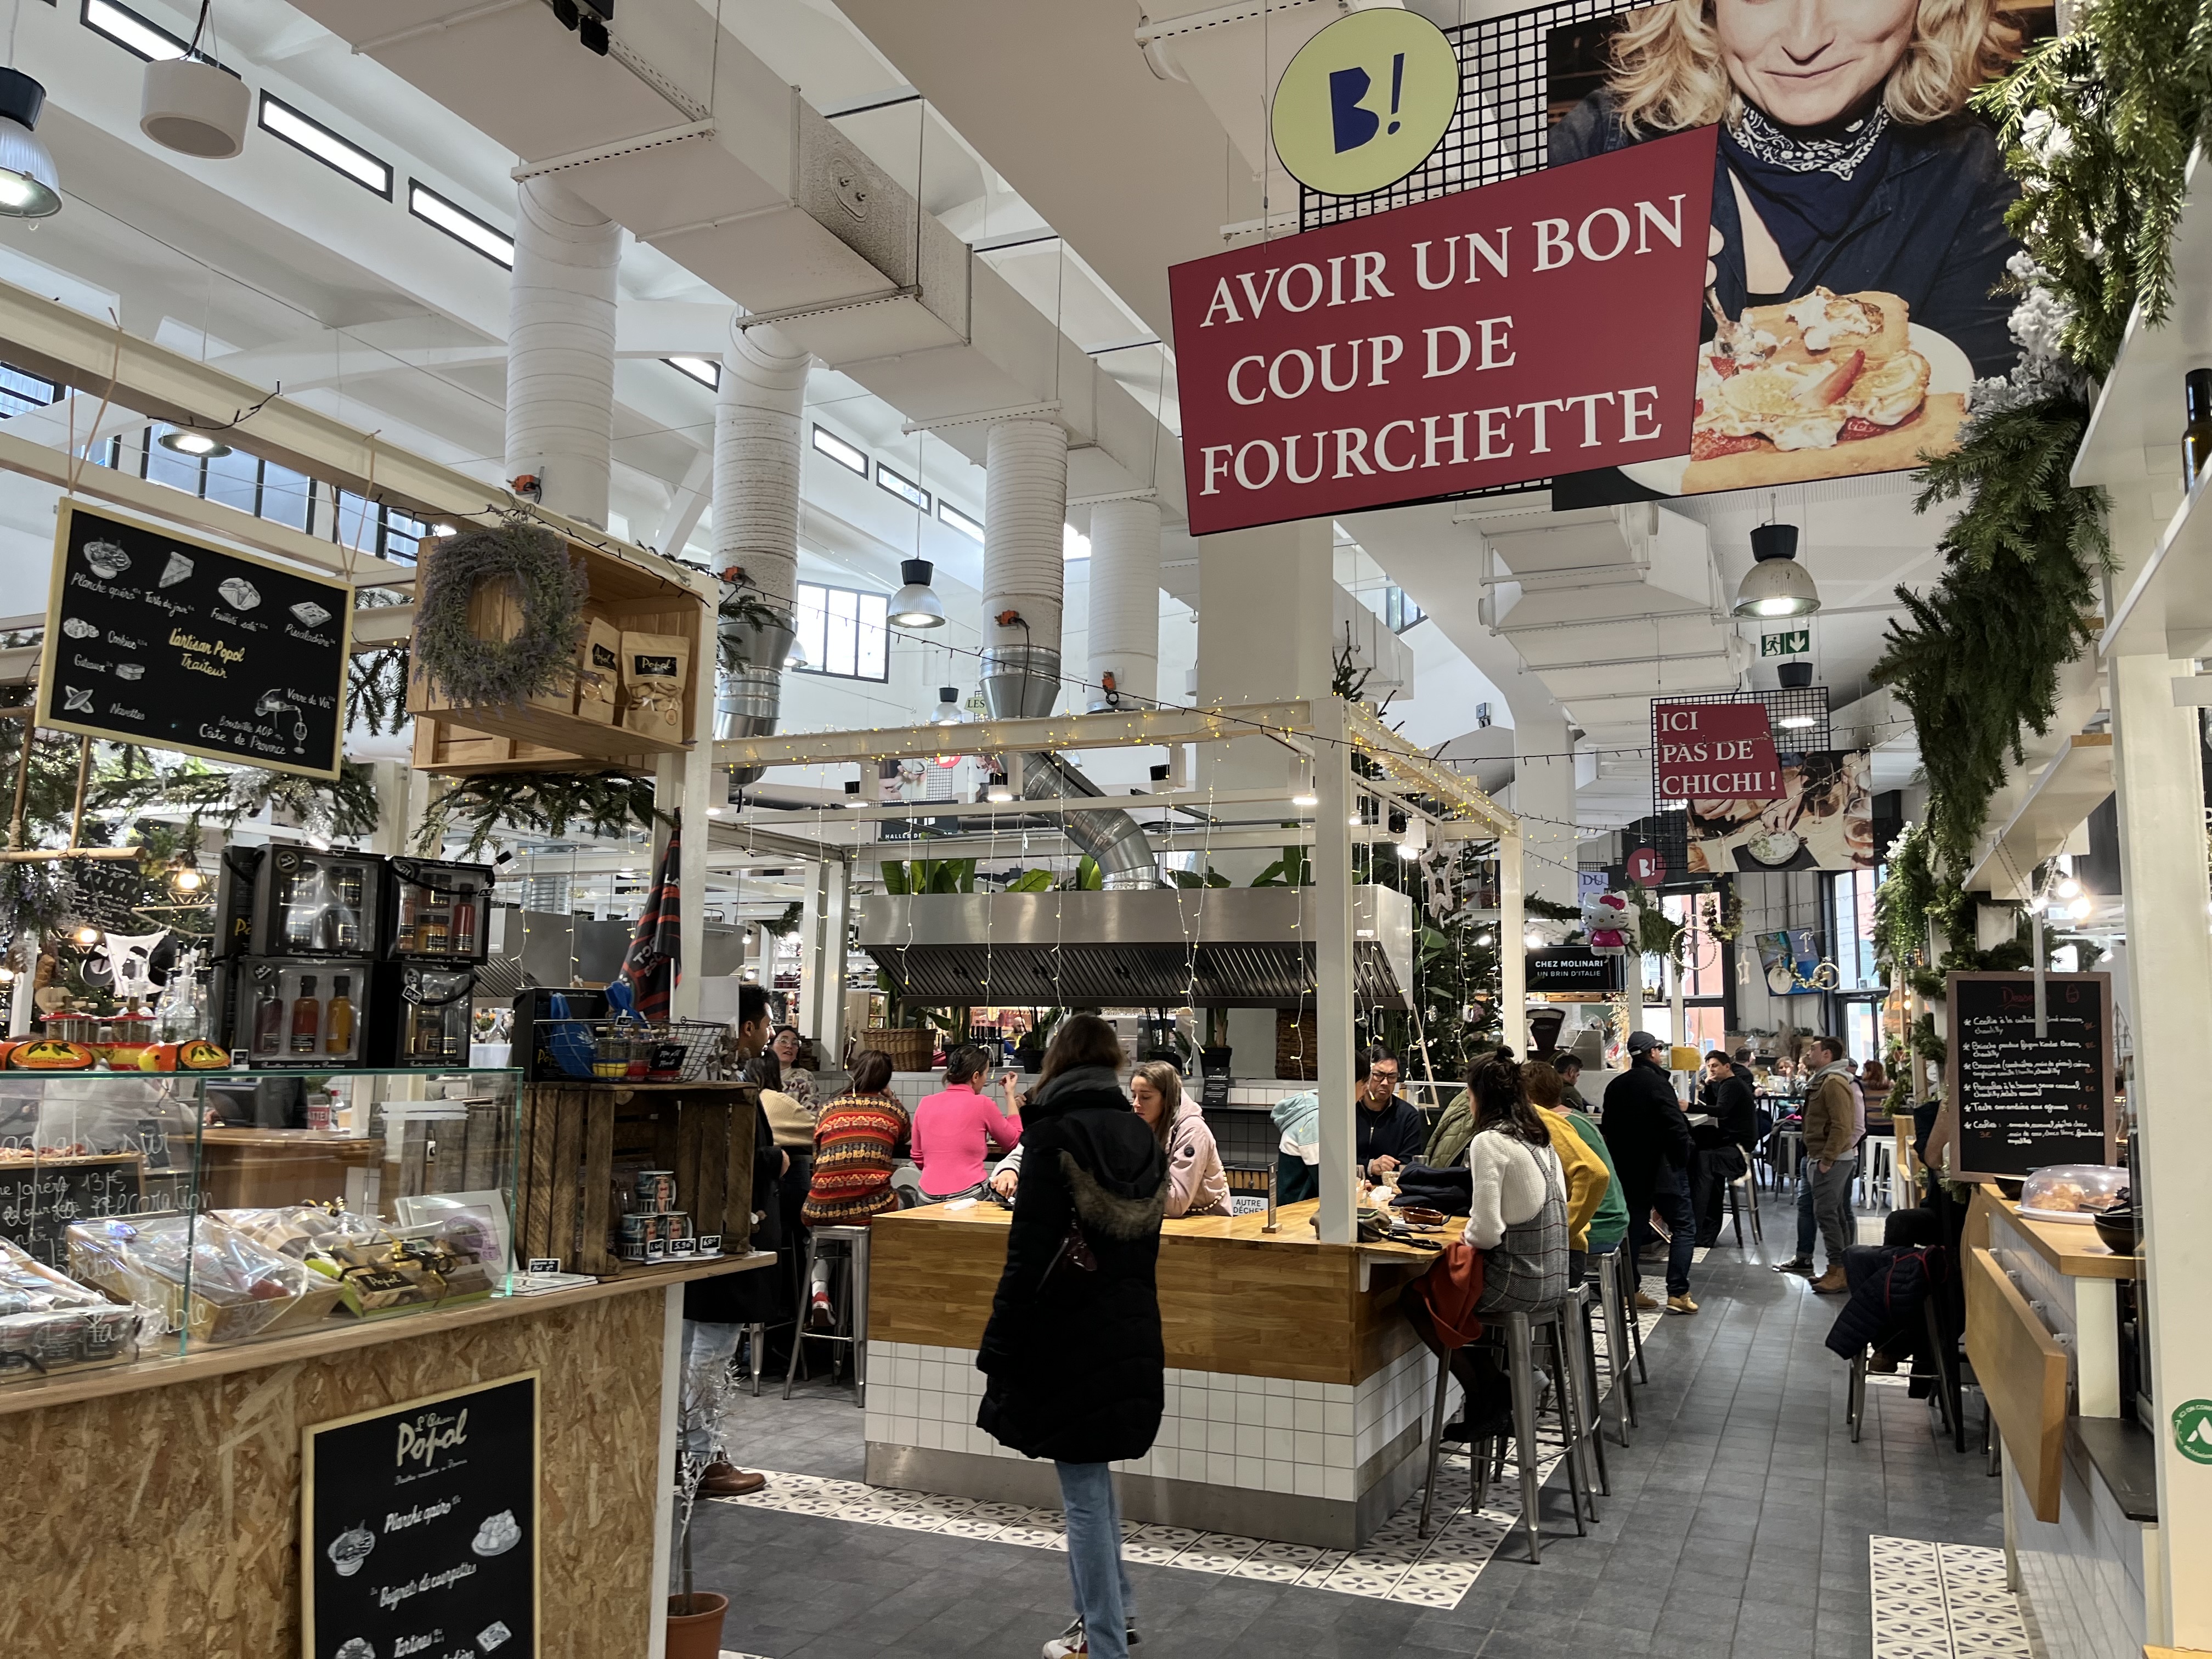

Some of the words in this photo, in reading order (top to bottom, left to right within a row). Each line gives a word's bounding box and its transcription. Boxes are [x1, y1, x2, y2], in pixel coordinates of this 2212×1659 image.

[1329, 53, 1404, 154] B!
[1200, 251, 1395, 328] AVOIR
[1412, 227, 1513, 290] UN
[1532, 194, 1686, 273] BON
[1227, 334, 1404, 406] COUP
[1423, 315, 1516, 380] DE
[1199, 386, 1662, 496] FOURCHETTE
[213, 640, 245, 664] Popol
[181, 653, 227, 679] Traiteur
[1661, 712, 1699, 732] ICI
[1662, 743, 1708, 764] PAS
[1716, 741, 1754, 761] DE
[1662, 772, 1762, 795] CHICHI
[1582, 874, 1603, 885] DU
[1639, 858, 1655, 878] B!
[1233, 1205, 1264, 1214] DÉCHE
[397, 1408, 468, 1467] Popol
